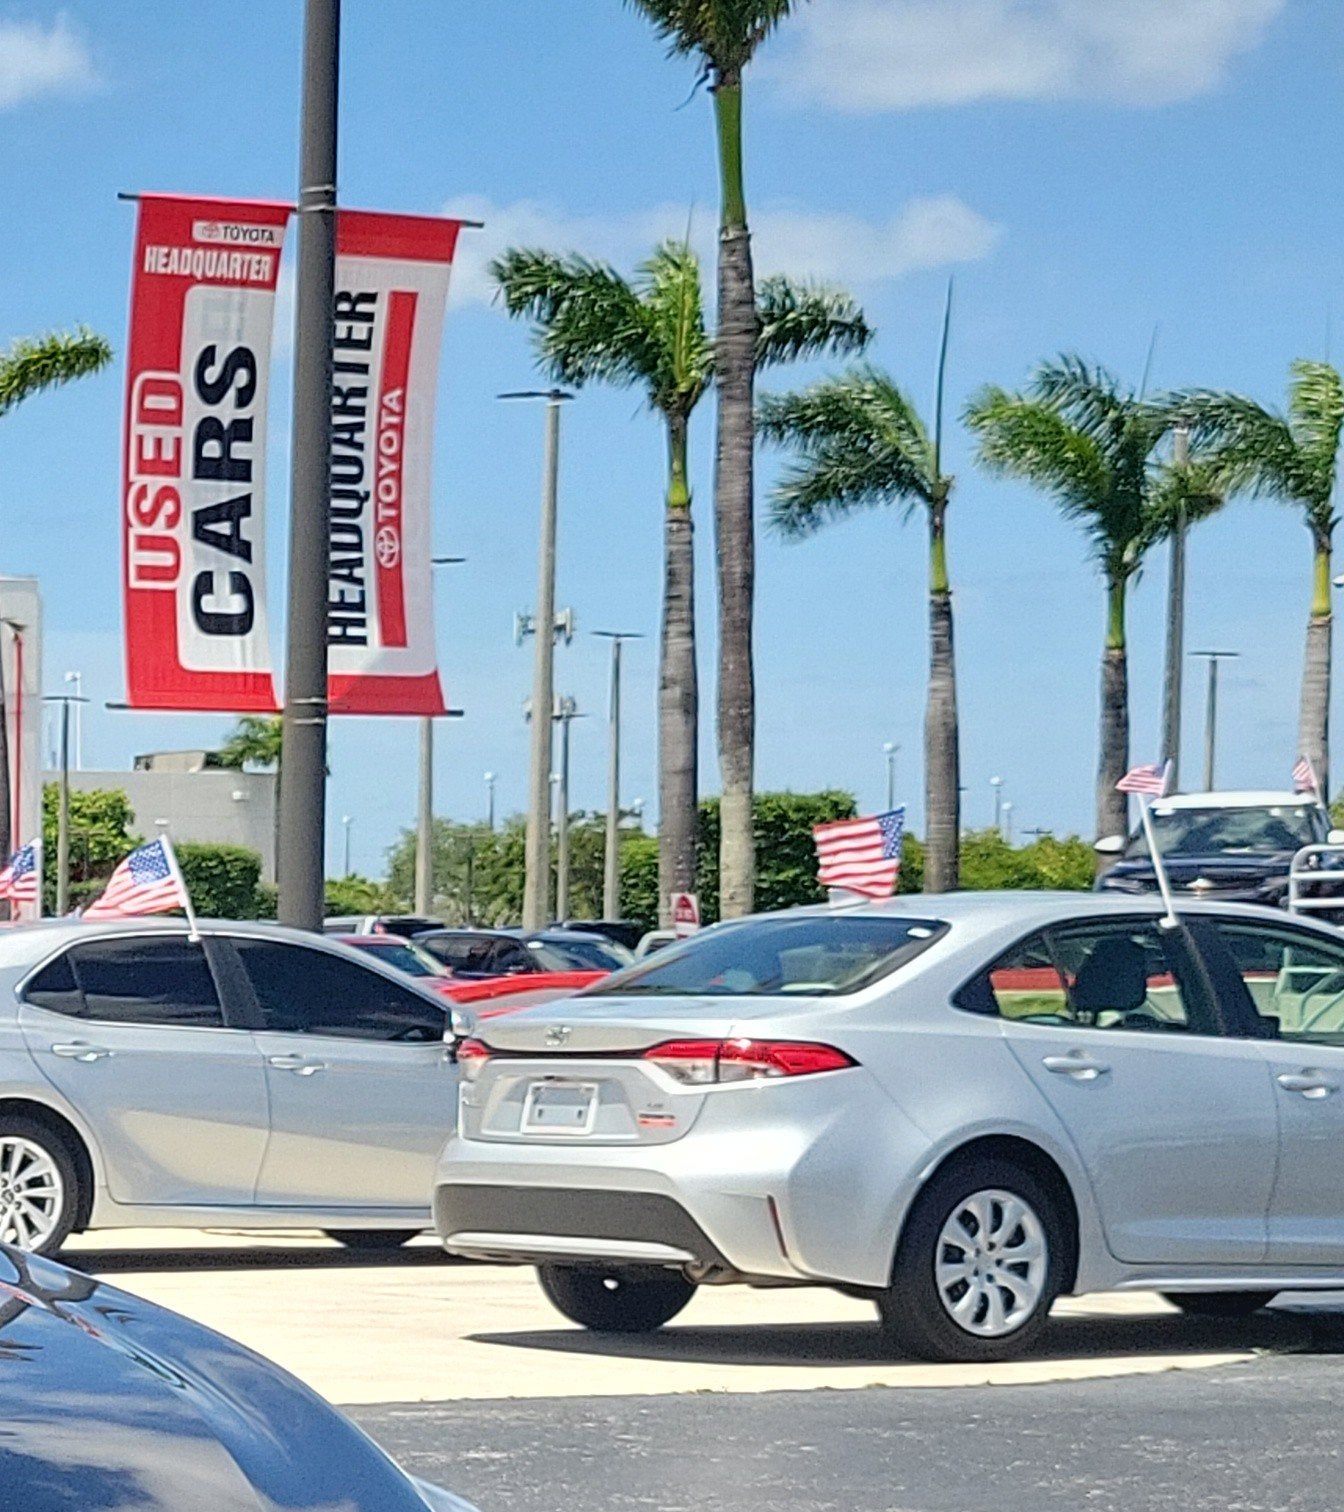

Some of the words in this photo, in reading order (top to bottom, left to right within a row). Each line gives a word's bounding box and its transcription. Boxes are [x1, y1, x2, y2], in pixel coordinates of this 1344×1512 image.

[144, 244, 274, 283] HEADQUARTER
[222, 225, 275, 244] TOYOTA
[129, 372, 183, 588] USED
[191, 344, 257, 637] CARS
[326, 290, 378, 647] HEADQUARTER
[377, 387, 403, 521] TOYOTA
